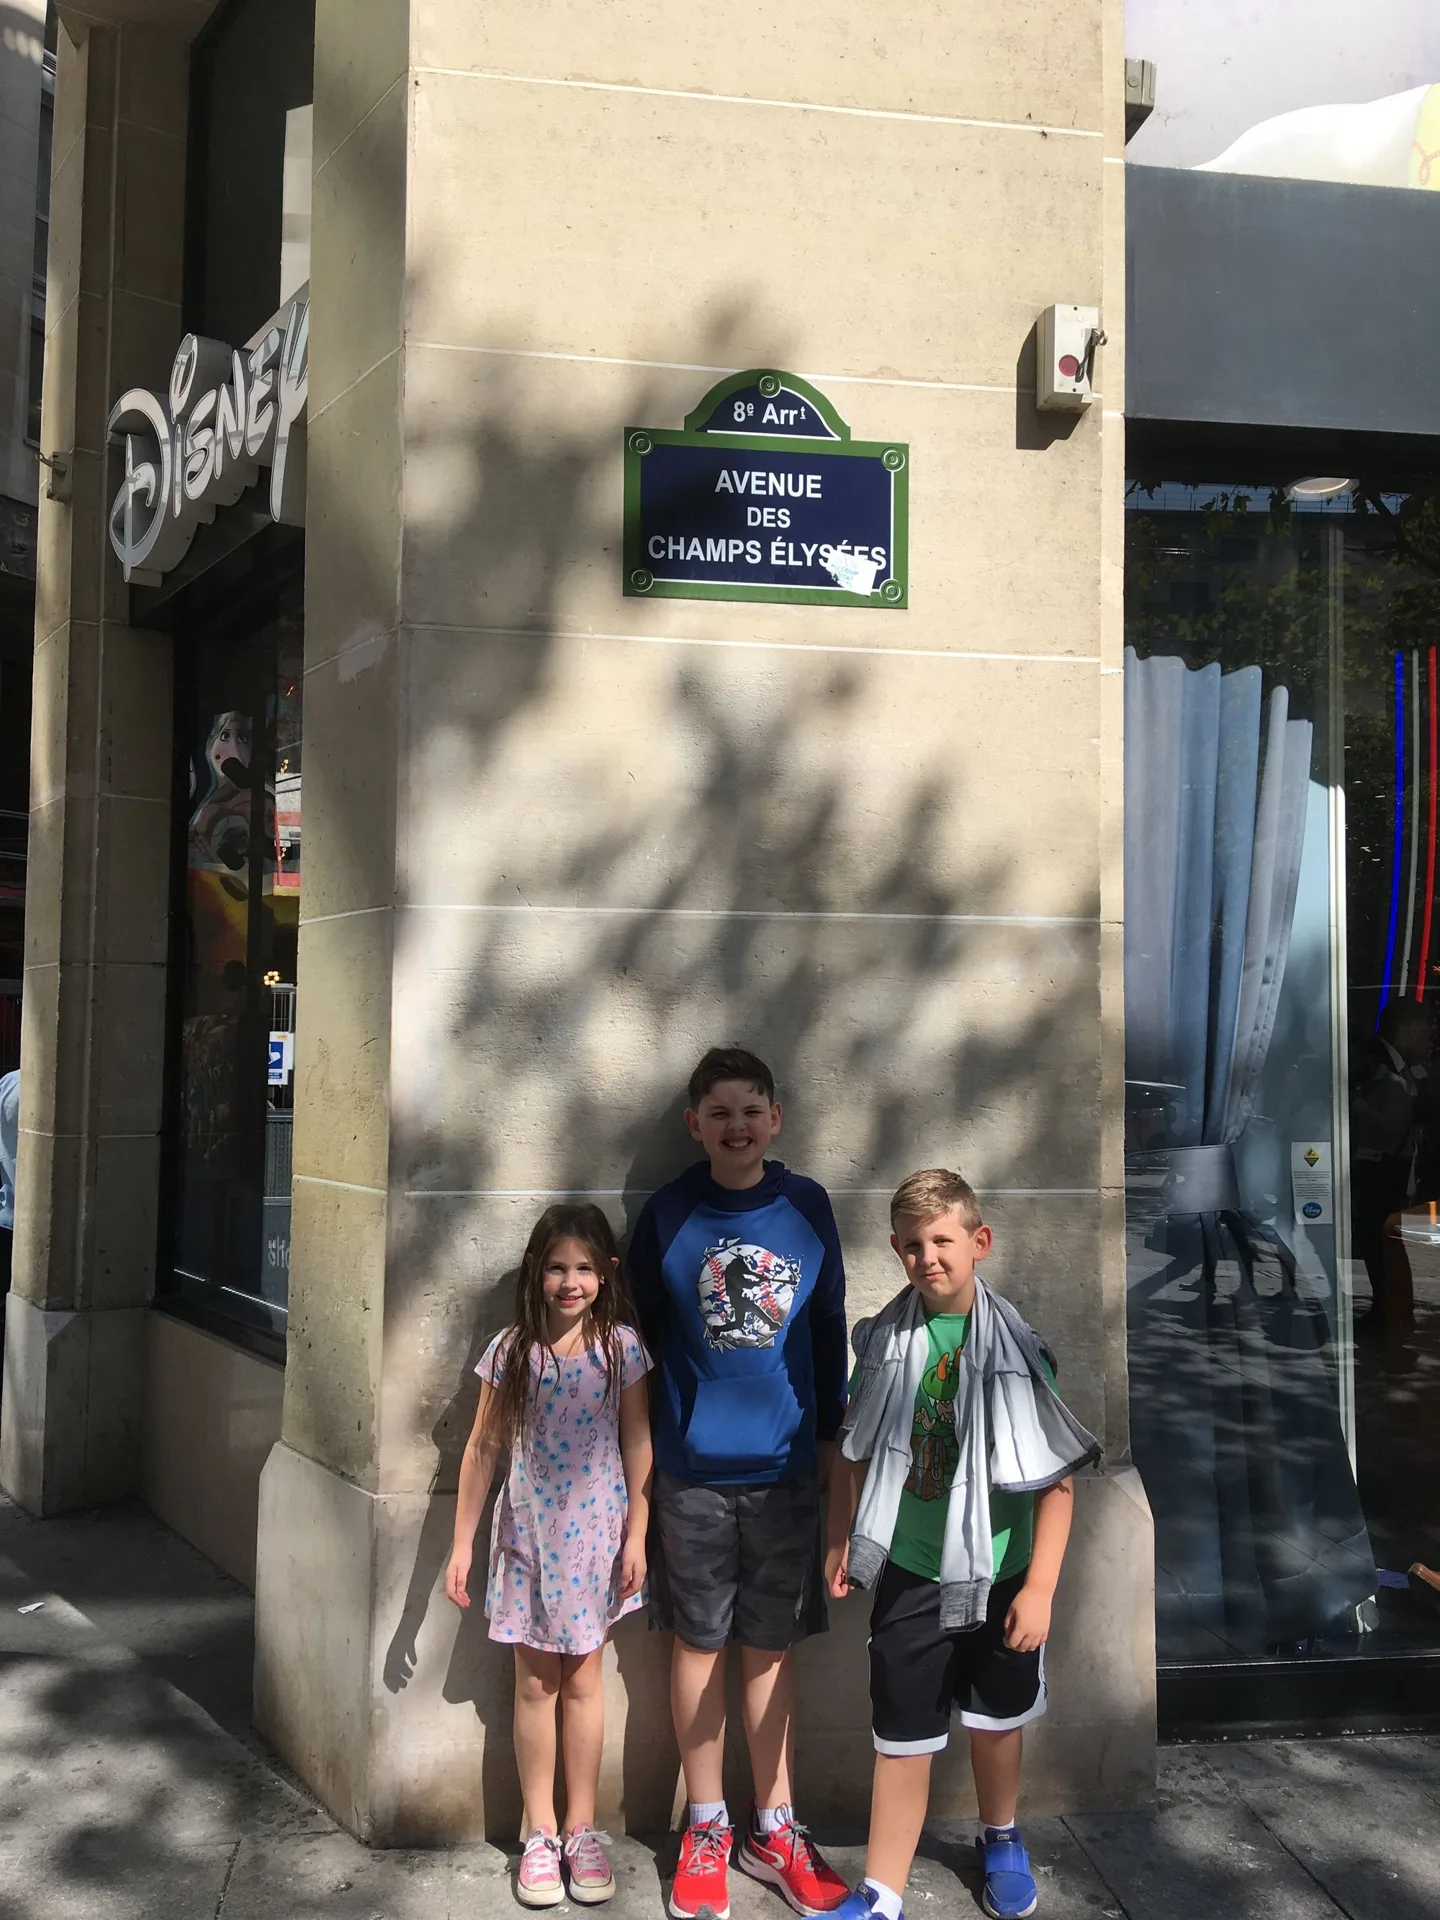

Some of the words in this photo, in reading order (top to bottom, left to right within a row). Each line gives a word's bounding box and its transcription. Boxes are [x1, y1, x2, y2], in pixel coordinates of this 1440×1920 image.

[714, 469, 822, 498] AVENUE
[746, 506, 791, 528] DES
[647, 535, 762, 564] CHAMPS
